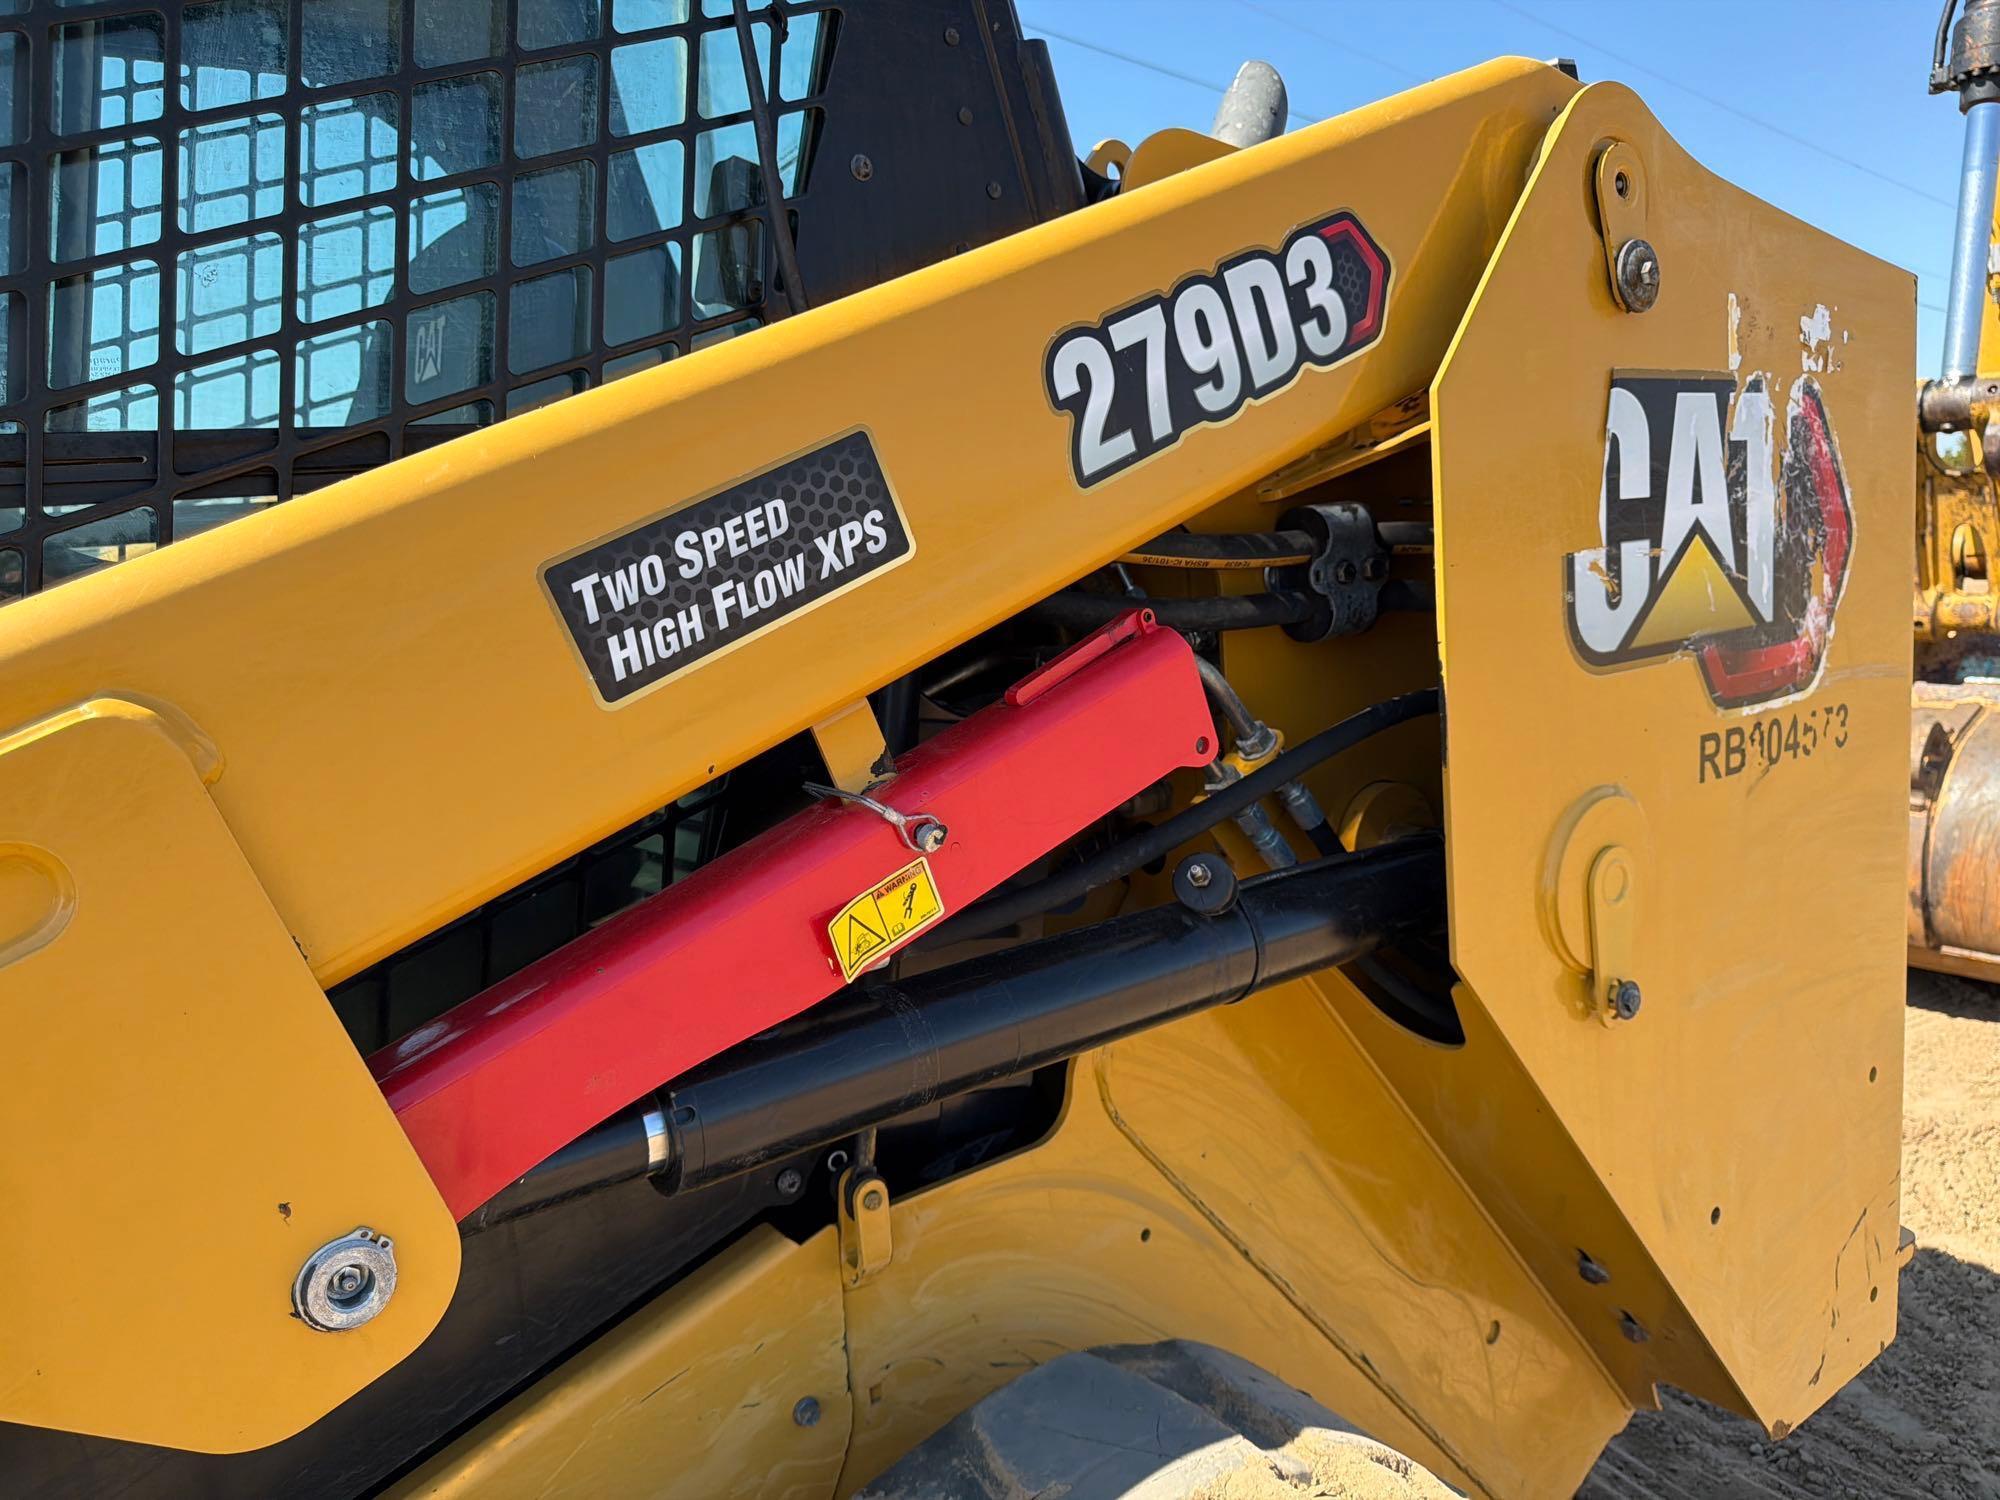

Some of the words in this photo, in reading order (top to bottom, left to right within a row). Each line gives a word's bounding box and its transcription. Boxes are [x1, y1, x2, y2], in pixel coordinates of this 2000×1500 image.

[414, 314, 447, 384] CAT
[1053, 235, 1348, 478] 279D3
[571, 554, 667, 625] TWO
[674, 498, 790, 580] SPEED
[606, 603, 705, 682] HIGH
[711, 552, 807, 631] FLOW
[813, 508, 888, 581] XPS
[884, 865, 923, 894] WARNING
